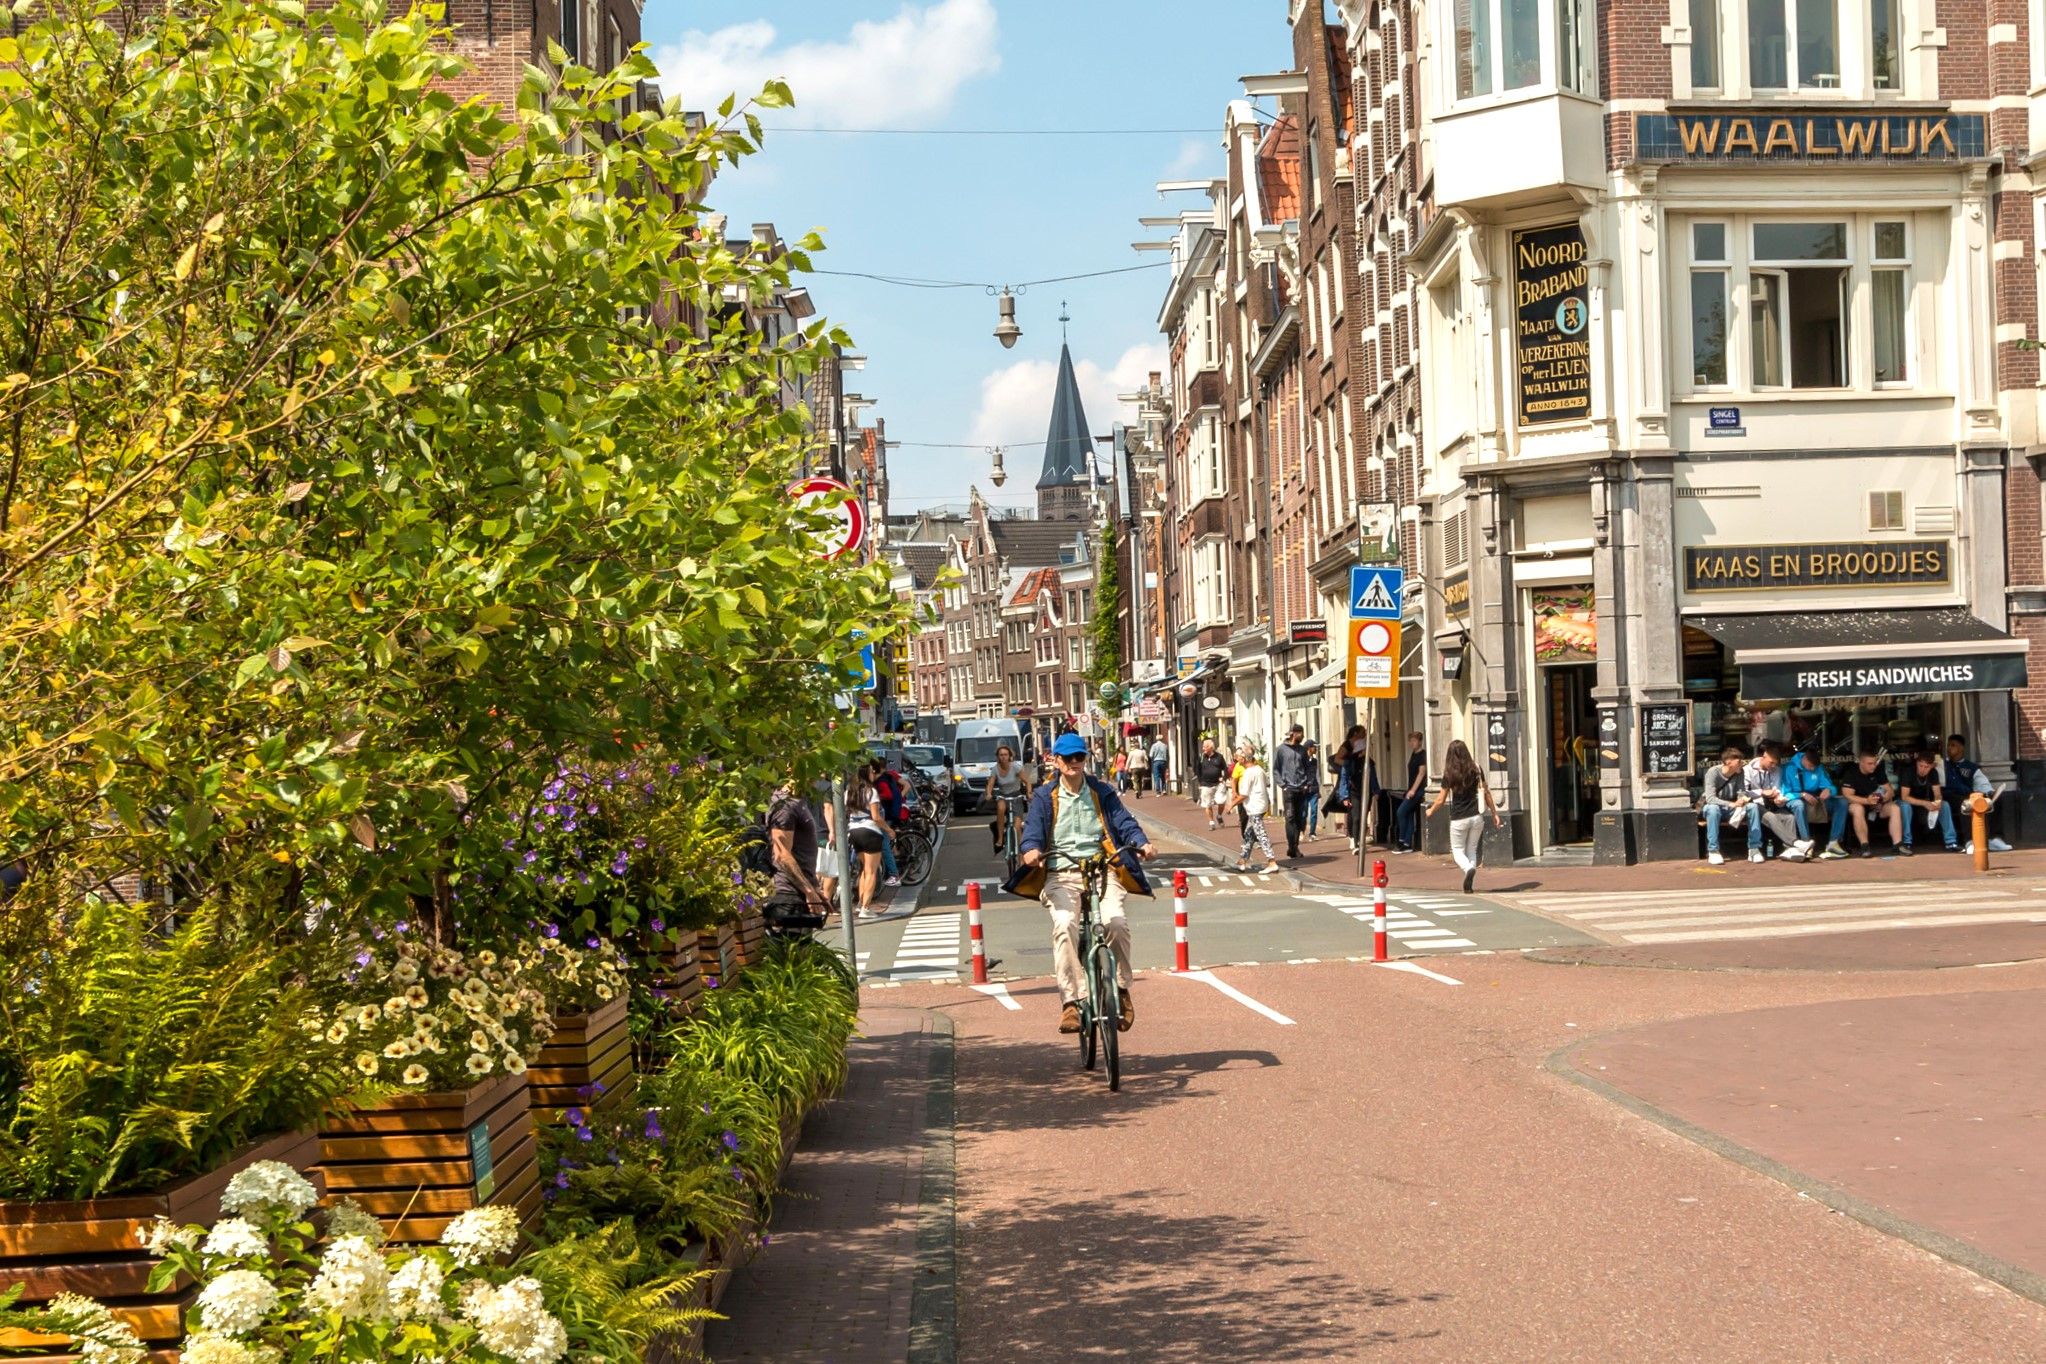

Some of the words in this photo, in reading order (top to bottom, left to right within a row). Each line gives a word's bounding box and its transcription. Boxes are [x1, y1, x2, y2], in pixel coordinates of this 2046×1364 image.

[1679, 118, 1956, 154] WAALWIJK
[1519, 266, 1587, 307] BRABAND
[1520, 340, 1590, 364] VERZEKERING
[1521, 365, 1535, 375] OP
[1533, 369, 1550, 380] HET
[1550, 358, 1590, 378] LEVEN
[1524, 377, 1588, 396] WAALWIJK
[1530, 401, 1557, 411] ANNO
[1559, 398, 1584, 407] 1843
[1695, 554, 1760, 579] KAAS
[1770, 554, 1800, 578] EN
[1810, 550, 1941, 577] BROODJES
[895, 625, 908, 693] OTEL
[1797, 669, 1852, 689] FRESH
[1855, 664, 1974, 686] SANDWICHES
